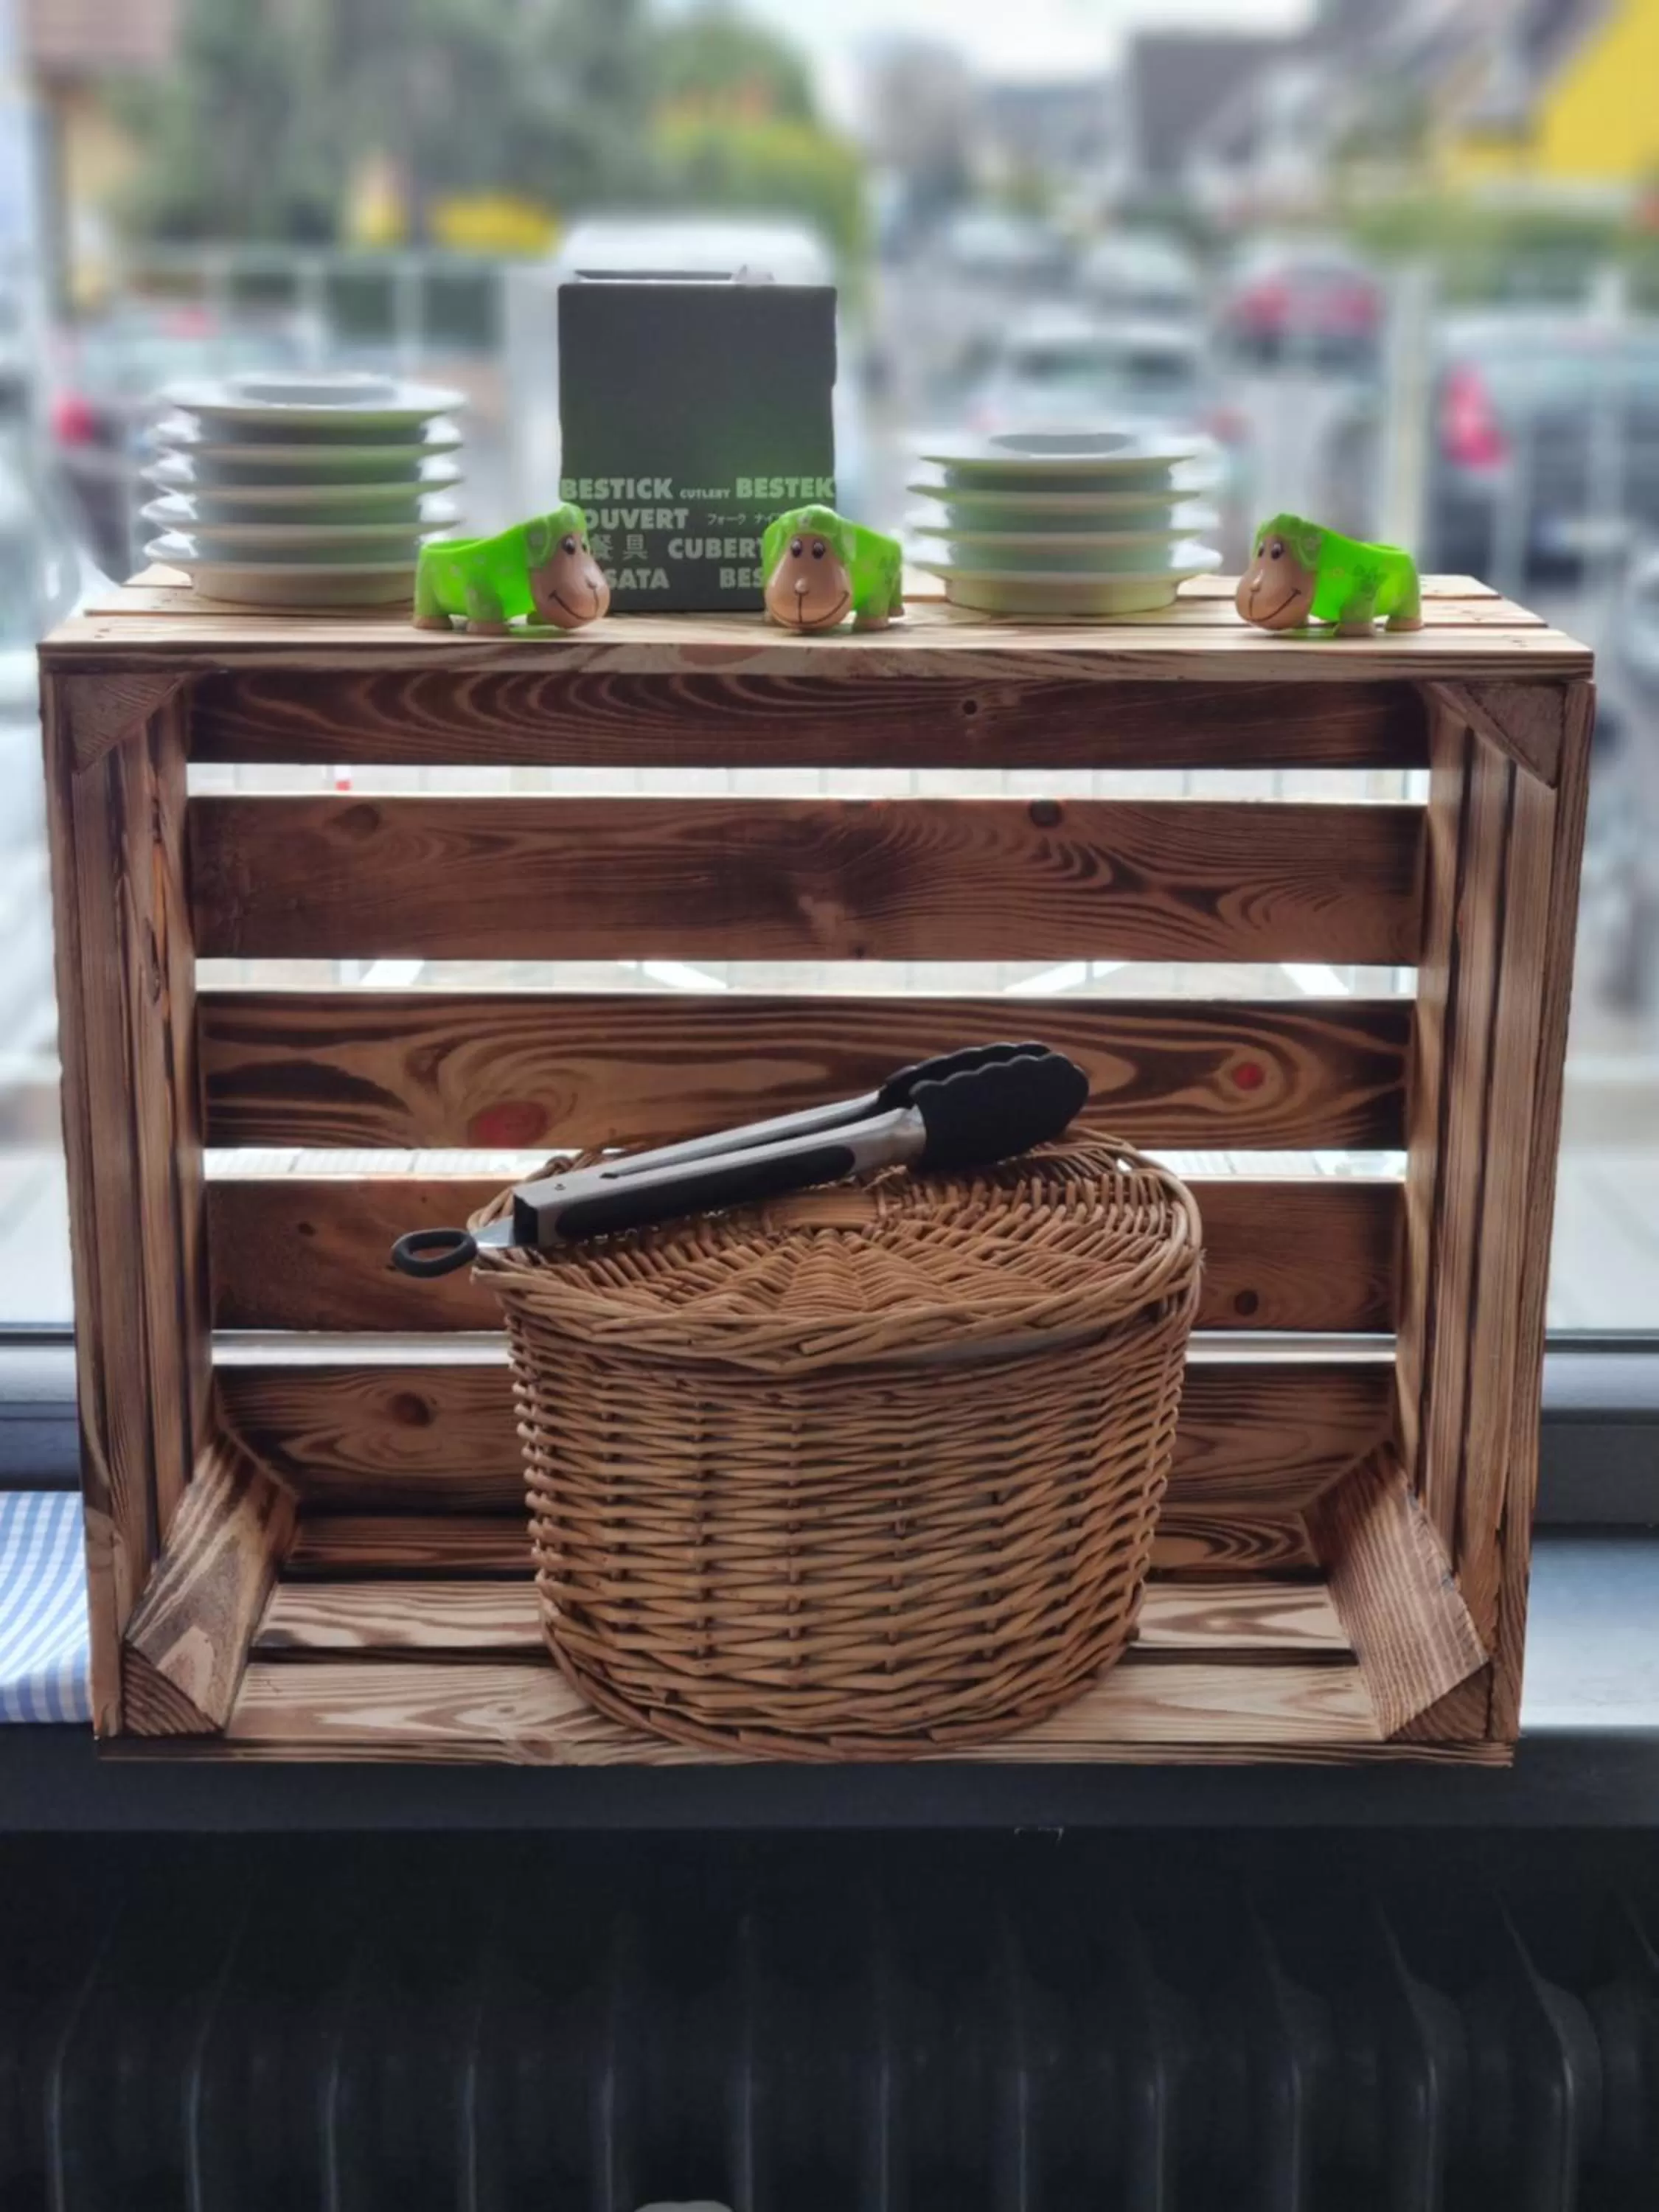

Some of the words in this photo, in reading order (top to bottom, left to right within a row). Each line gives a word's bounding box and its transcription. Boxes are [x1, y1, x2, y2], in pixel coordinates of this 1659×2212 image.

[560, 477, 673, 499] BESTICK
[736, 477, 834, 498] BESTEK
[585, 508, 689, 529] OUVERT
[605, 567, 670, 589] SATA
[720, 567, 765, 589] BES
